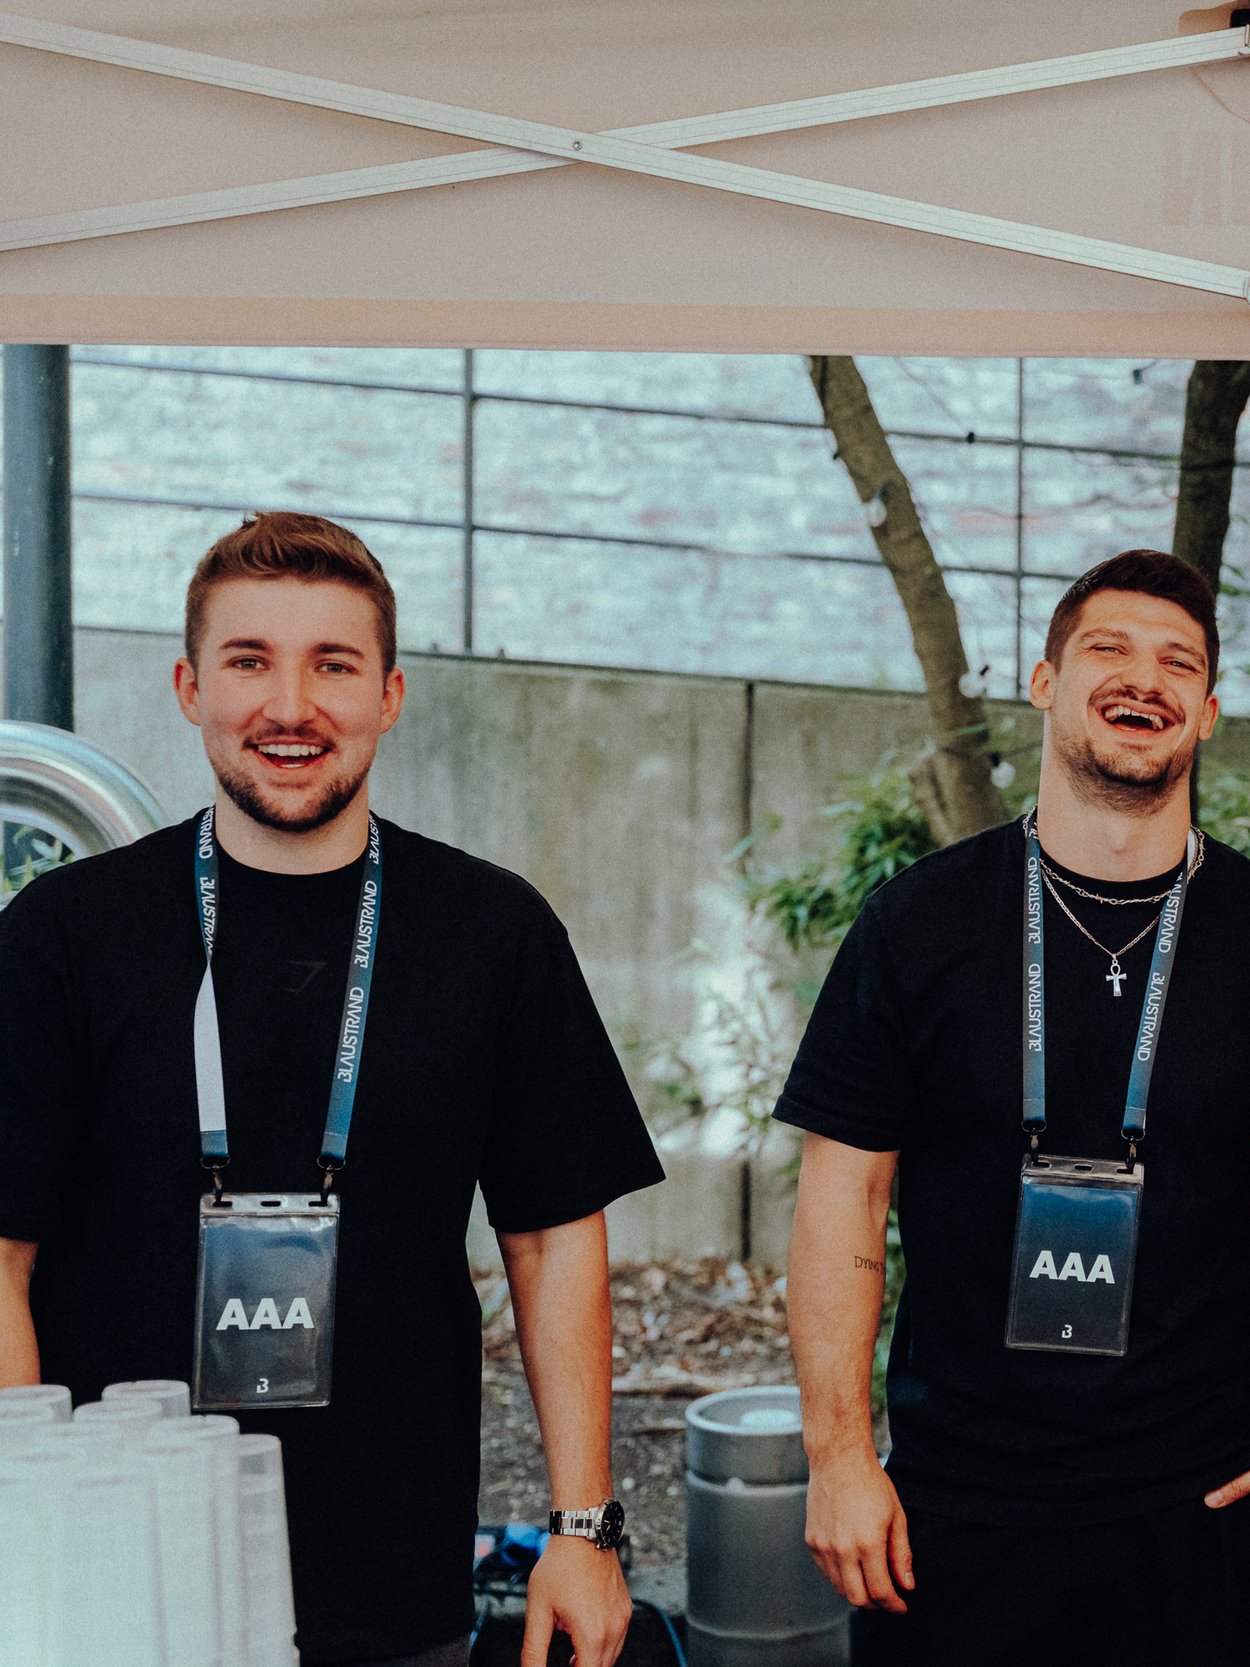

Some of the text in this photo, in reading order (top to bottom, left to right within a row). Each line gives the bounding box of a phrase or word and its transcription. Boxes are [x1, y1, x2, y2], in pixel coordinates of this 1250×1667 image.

[199, 806, 214, 859] STRAND
[354, 880, 378, 969] BLAUSTRAND
[1028, 856, 1041, 945] BLAUSTRAND
[337, 986, 365, 1083] BLAUSTRAND
[1028, 963, 1042, 1052] BLAUSTRAND
[1137, 972, 1165, 1062] BLAUSTRAND
[1029, 1250, 1116, 1285] AAA
[216, 1298, 315, 1331] AAA
